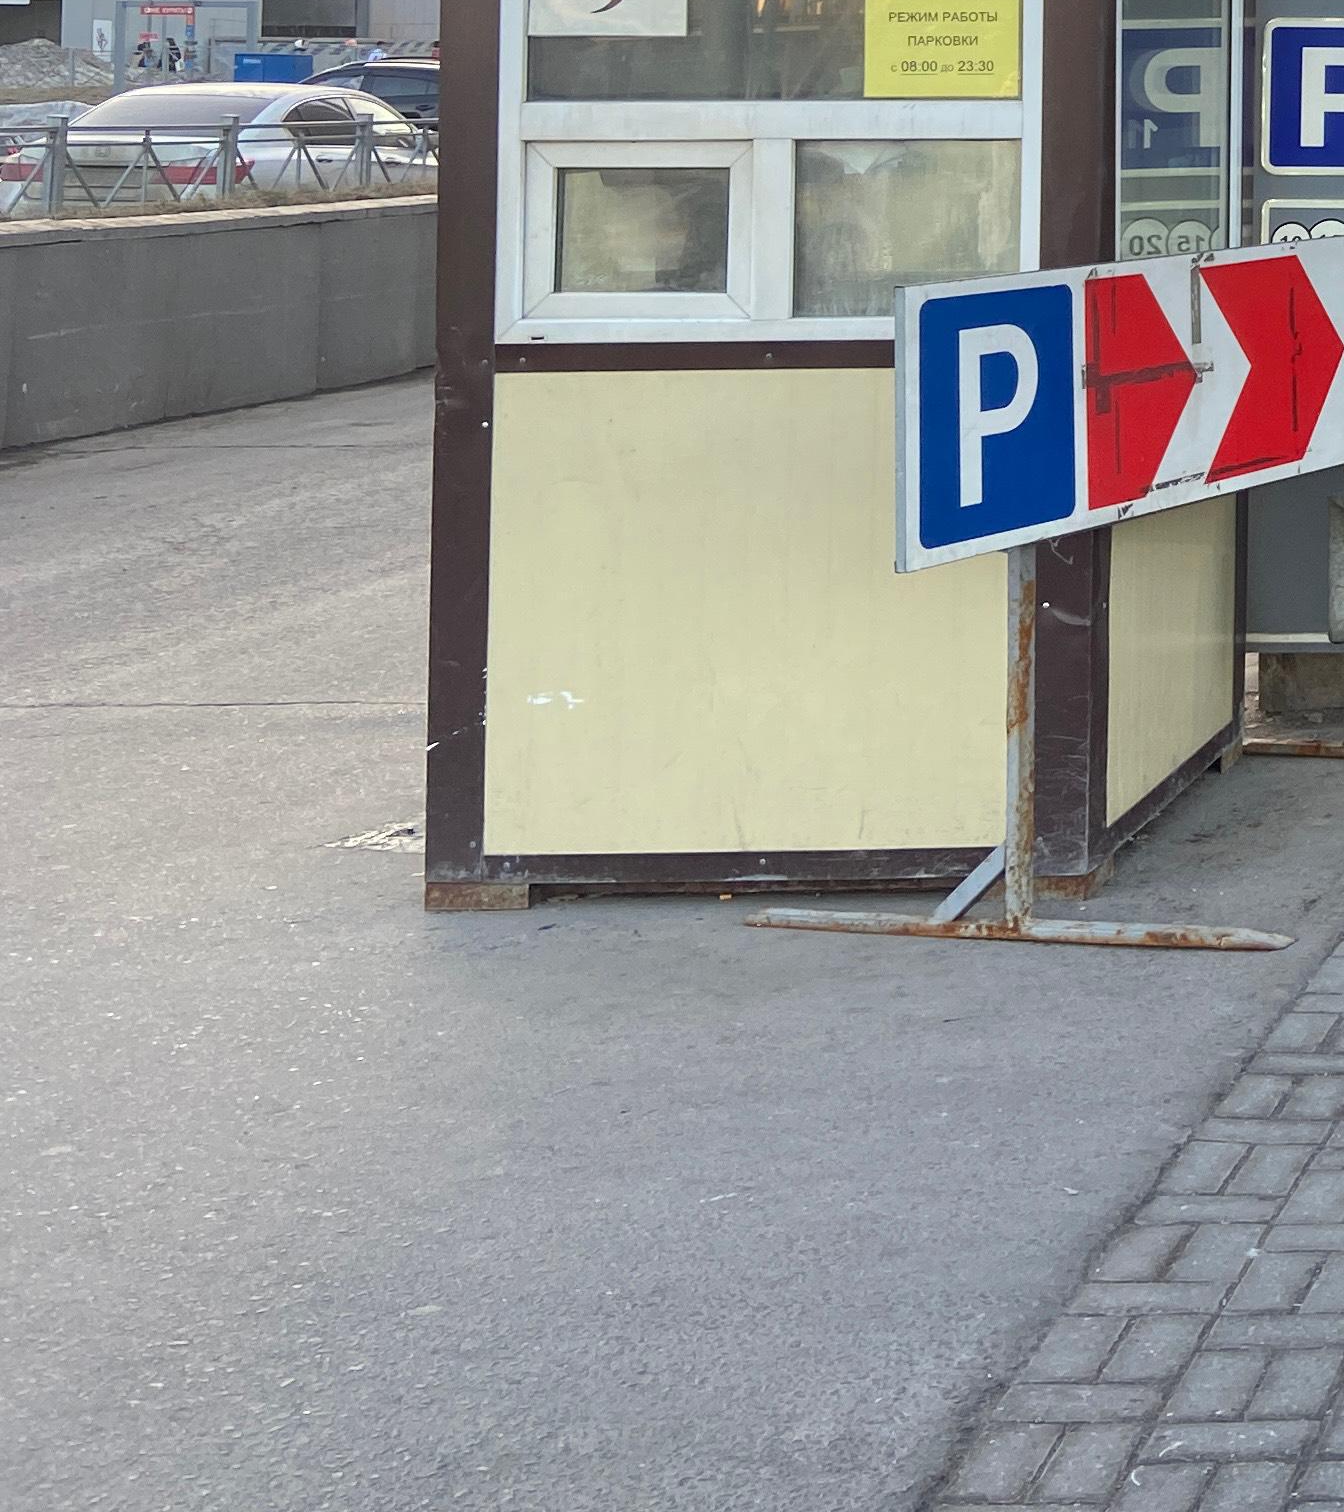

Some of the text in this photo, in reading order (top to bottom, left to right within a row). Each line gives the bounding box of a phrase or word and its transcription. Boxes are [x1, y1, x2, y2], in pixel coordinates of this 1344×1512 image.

[888, 11, 998, 22] РЕЖИМ РАБОТЫ
[907, 35, 979, 46] ПАРКОВКИ
[901, 60, 938, 72] 08:00
[940, 64, 954, 73] до
[957, 60, 994, 72] 23:30
[957, 323, 1039, 509] P
